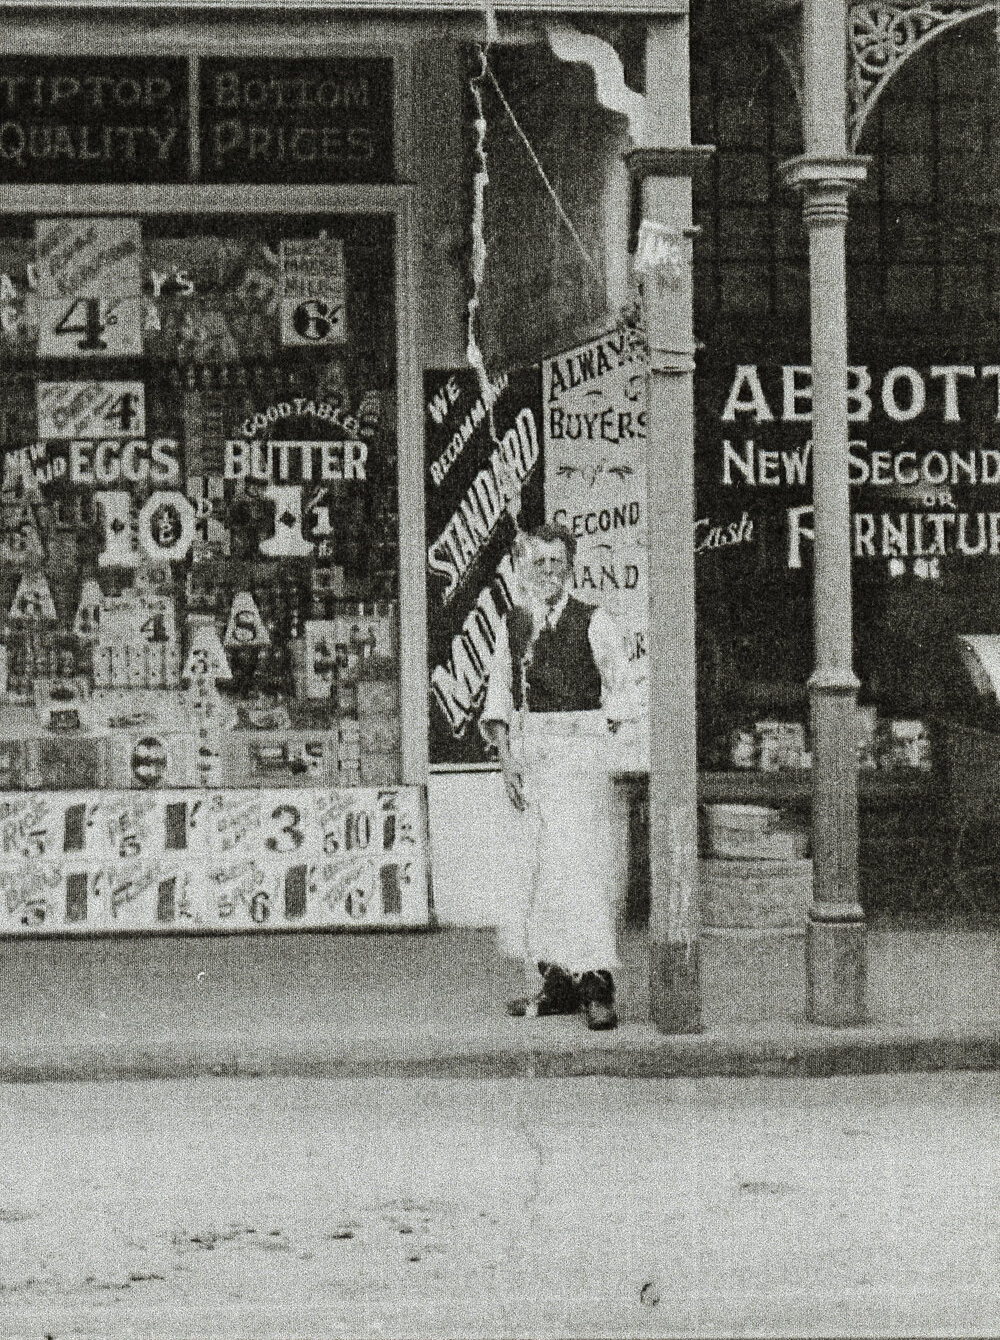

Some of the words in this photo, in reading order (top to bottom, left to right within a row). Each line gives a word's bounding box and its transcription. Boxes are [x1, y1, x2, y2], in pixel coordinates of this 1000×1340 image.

[213, 71, 372, 110] BOTTOM
[0, 121, 178, 167] QUALITY
[212, 121, 376, 164] PRICES
[68, 438, 181, 484] EGGS
[223, 439, 369, 480] BUTTER
[427, 407, 541, 605] STANDARD
[786, 505, 1000, 568] FRNITU
